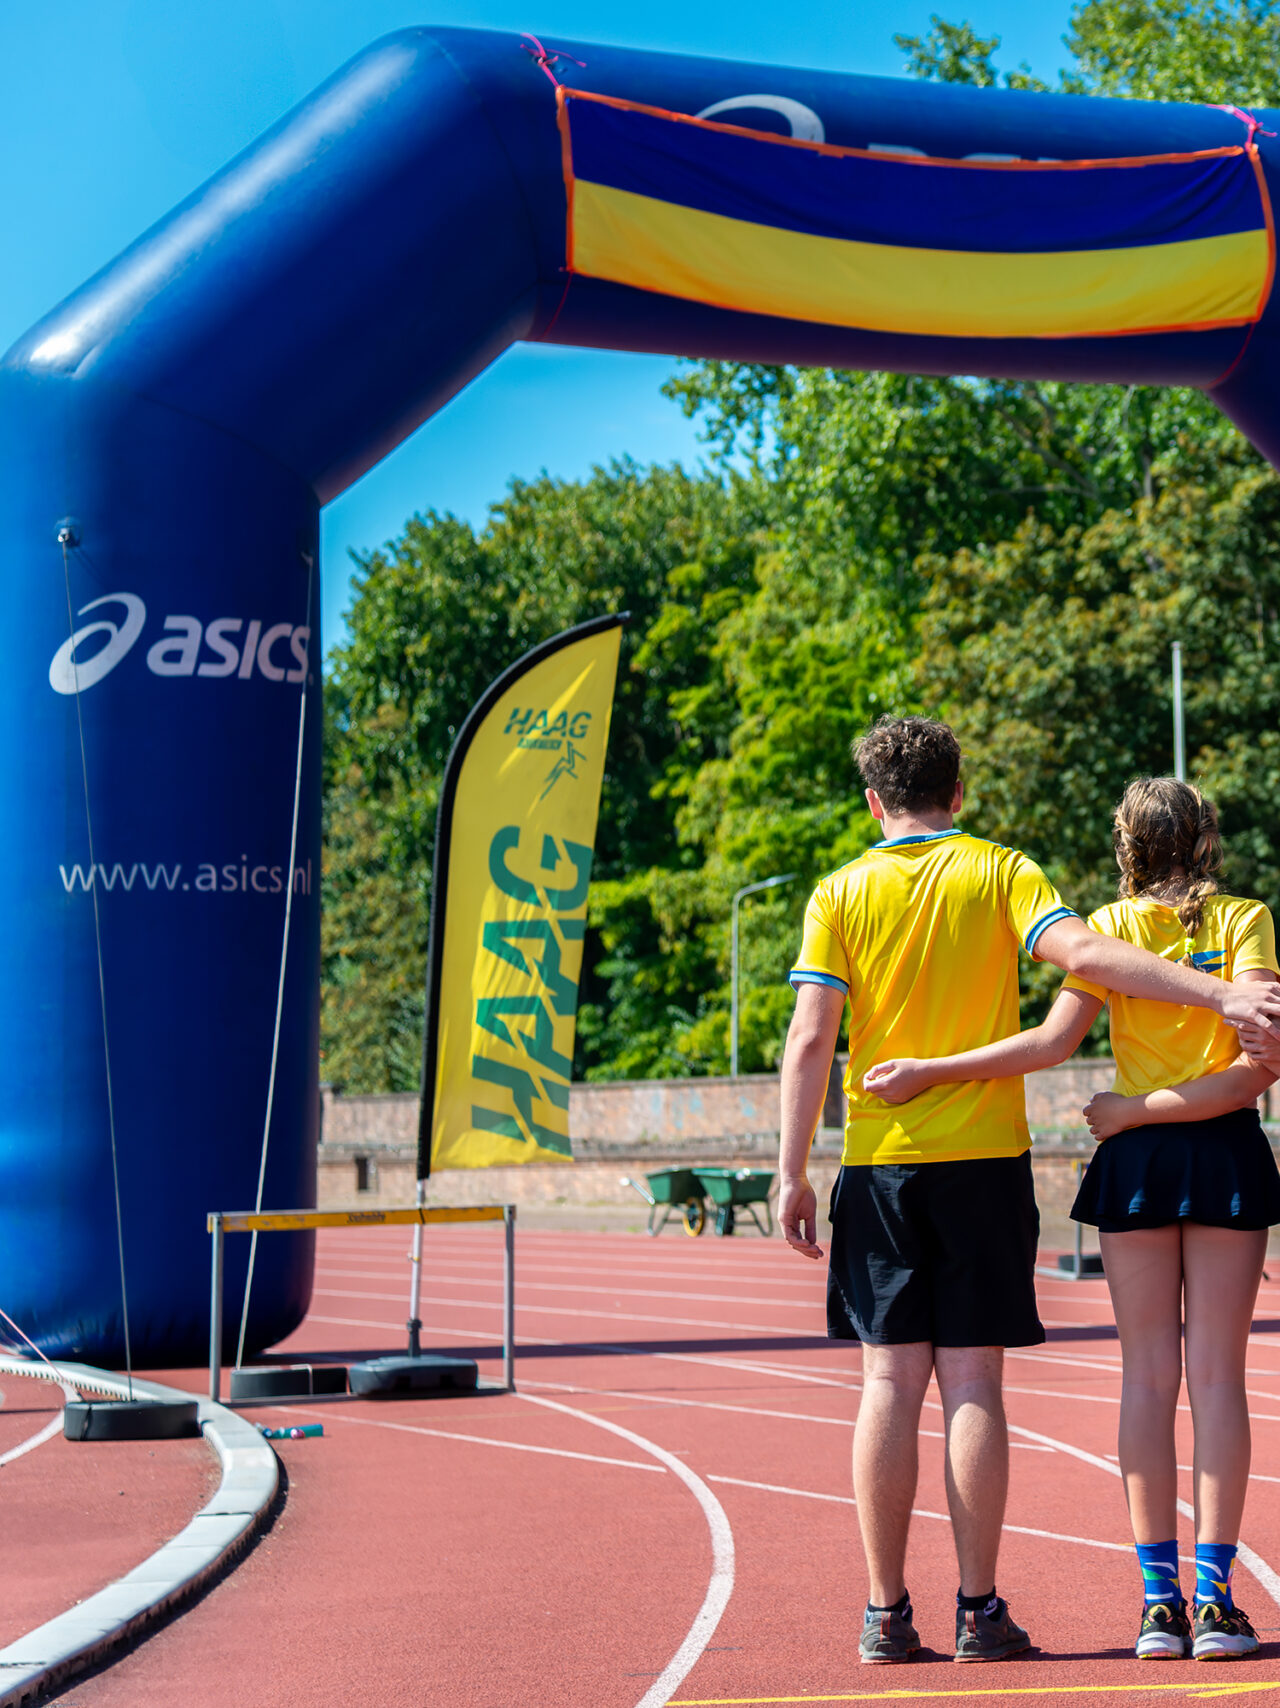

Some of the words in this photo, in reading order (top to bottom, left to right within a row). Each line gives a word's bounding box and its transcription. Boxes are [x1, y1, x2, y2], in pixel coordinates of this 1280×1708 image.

[146, 614, 311, 684] asics
[504, 707, 592, 739] HAAG
[58, 854, 312, 896] www.asicsnl
[471, 824, 593, 1157] HAAG
